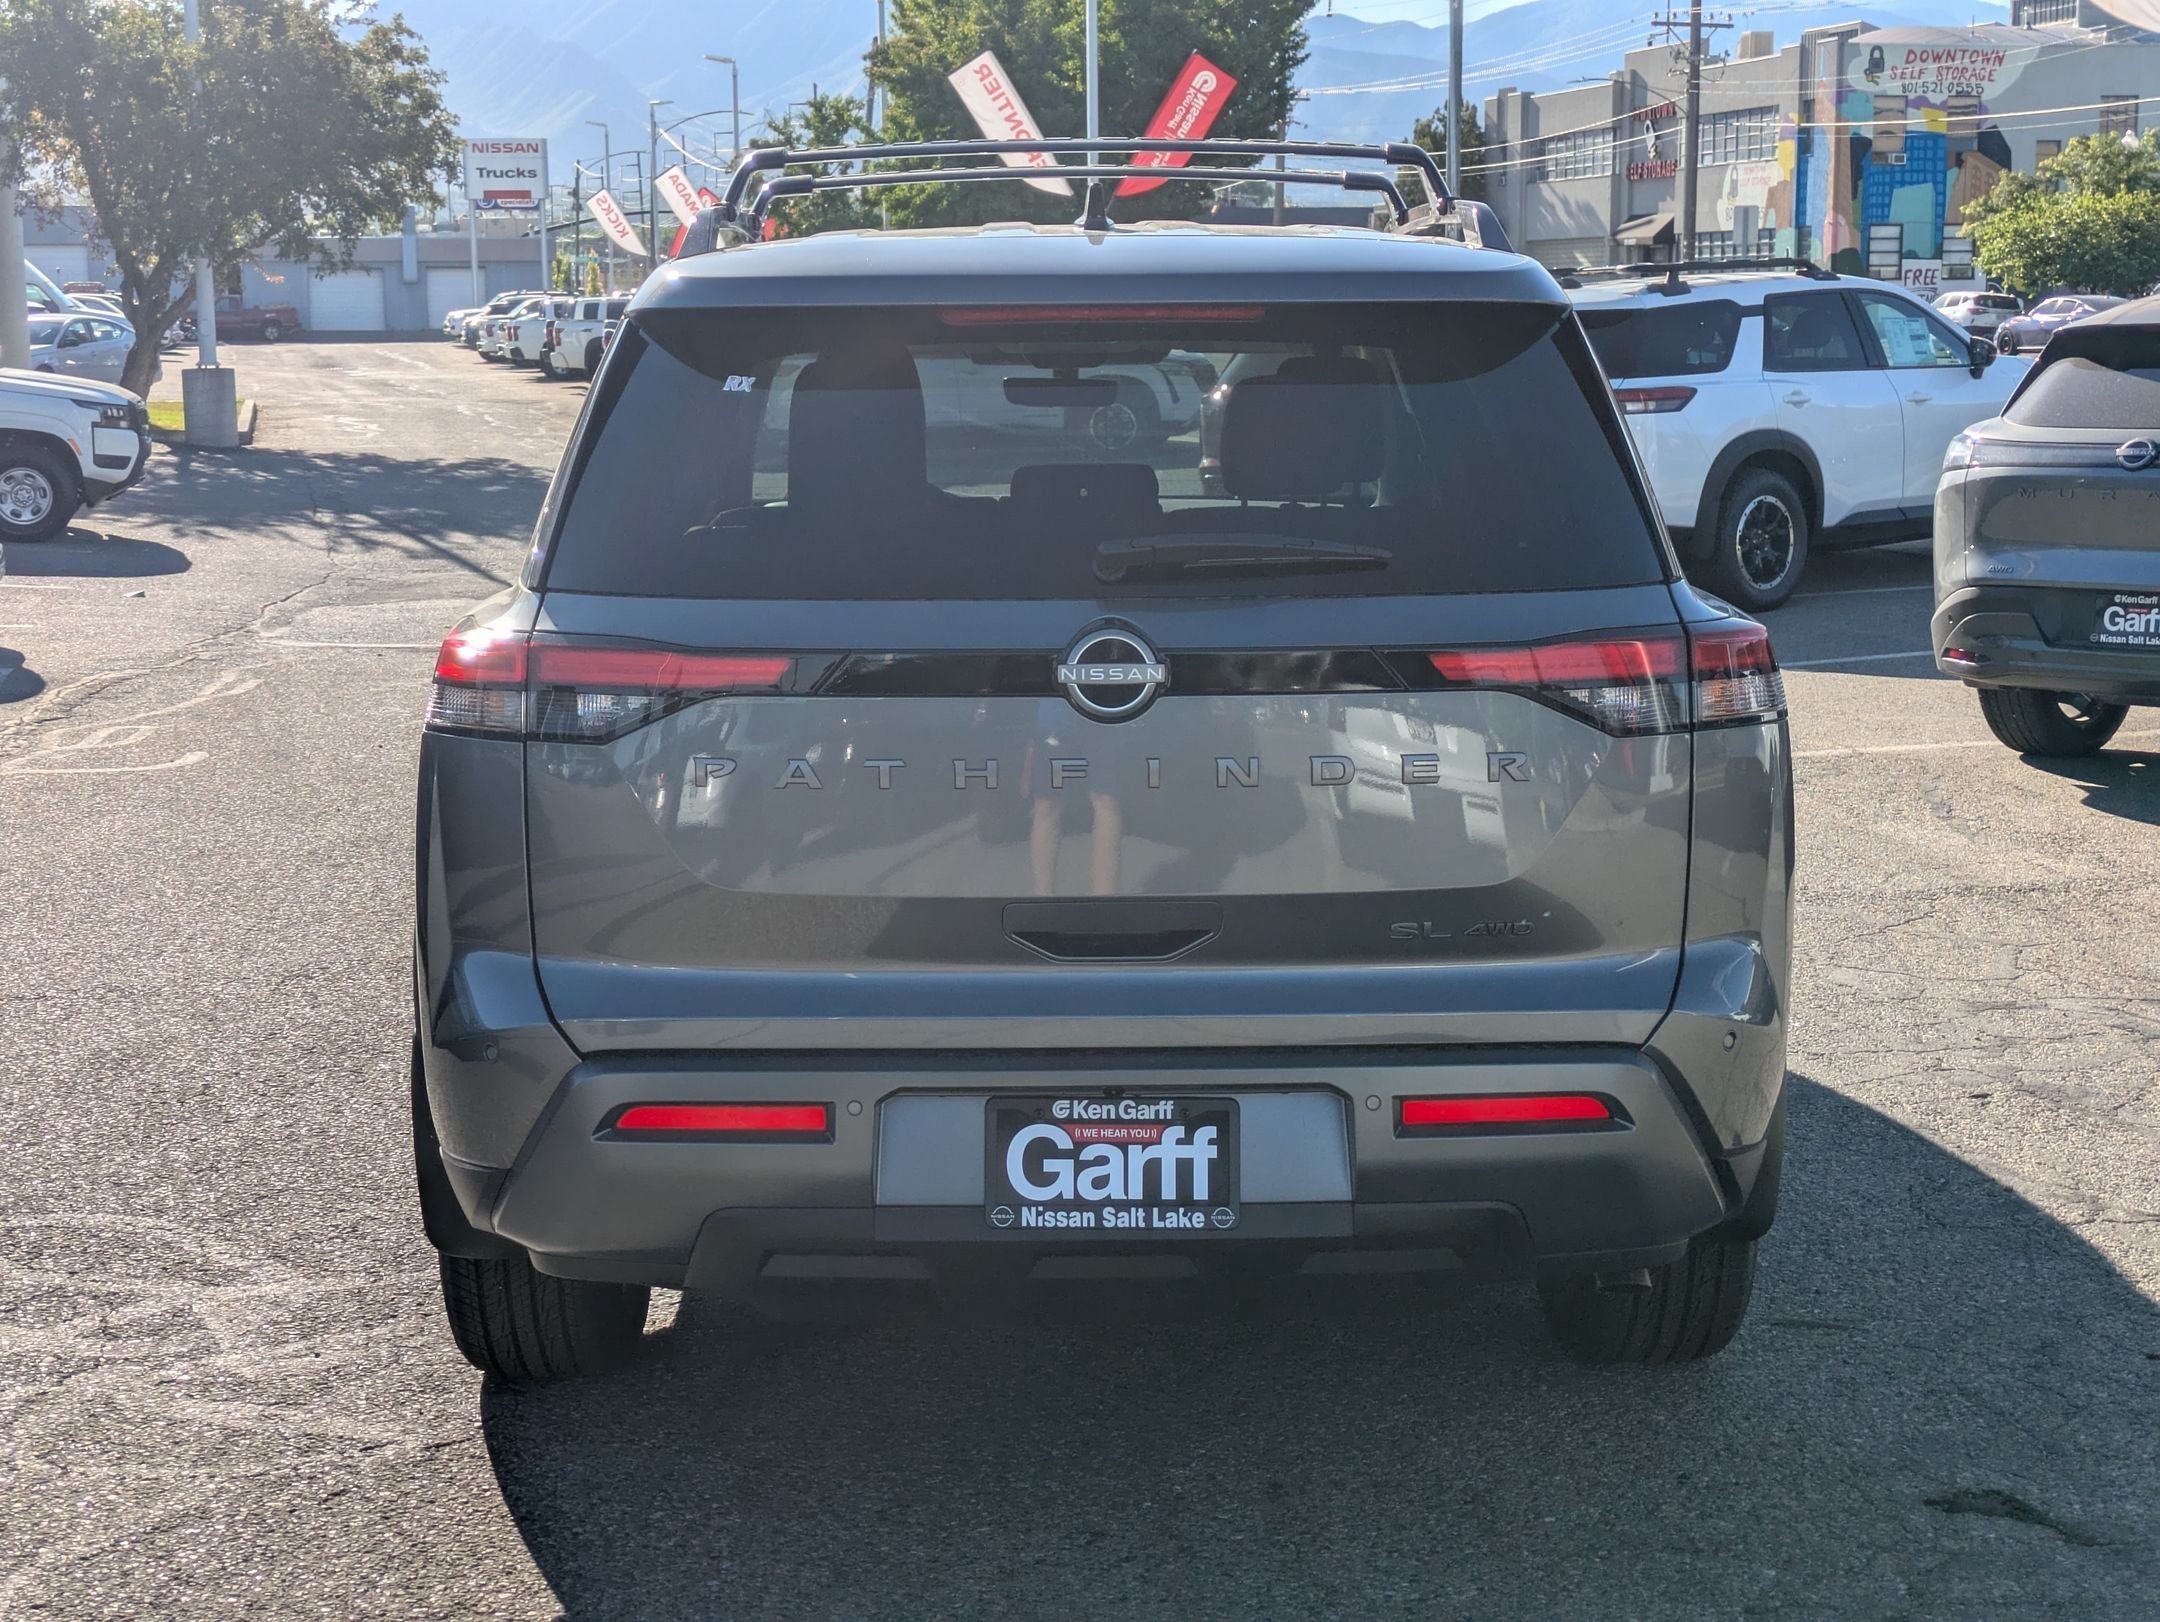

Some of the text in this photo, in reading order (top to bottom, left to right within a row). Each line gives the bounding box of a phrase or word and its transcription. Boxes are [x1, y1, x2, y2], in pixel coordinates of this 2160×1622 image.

[1905, 48, 2007, 66] DOWNTOWN
[1890, 66, 1997, 82] SELF STORAGE
[472, 143, 539, 154] NISSAN
[476, 167, 537, 178] Trucks
[1904, 268, 1939, 286] FREE
[2018, 487, 2160, 500] MURA
[2103, 606, 2160, 633] Garf
[2100, 634, 2160, 646] Nissan Salt Lak
[1061, 668, 1162, 681] NISSAN
[693, 751, 1529, 789] PATHFINDER
[1390, 922, 1451, 939] SL
[1073, 1100, 1174, 1119] Ken Garff
[1083, 1128, 1149, 1138] WE HEAR YOU
[1006, 1124, 1218, 1200] Garff
[1021, 1206, 1205, 1228] Nissan Salt Lake
